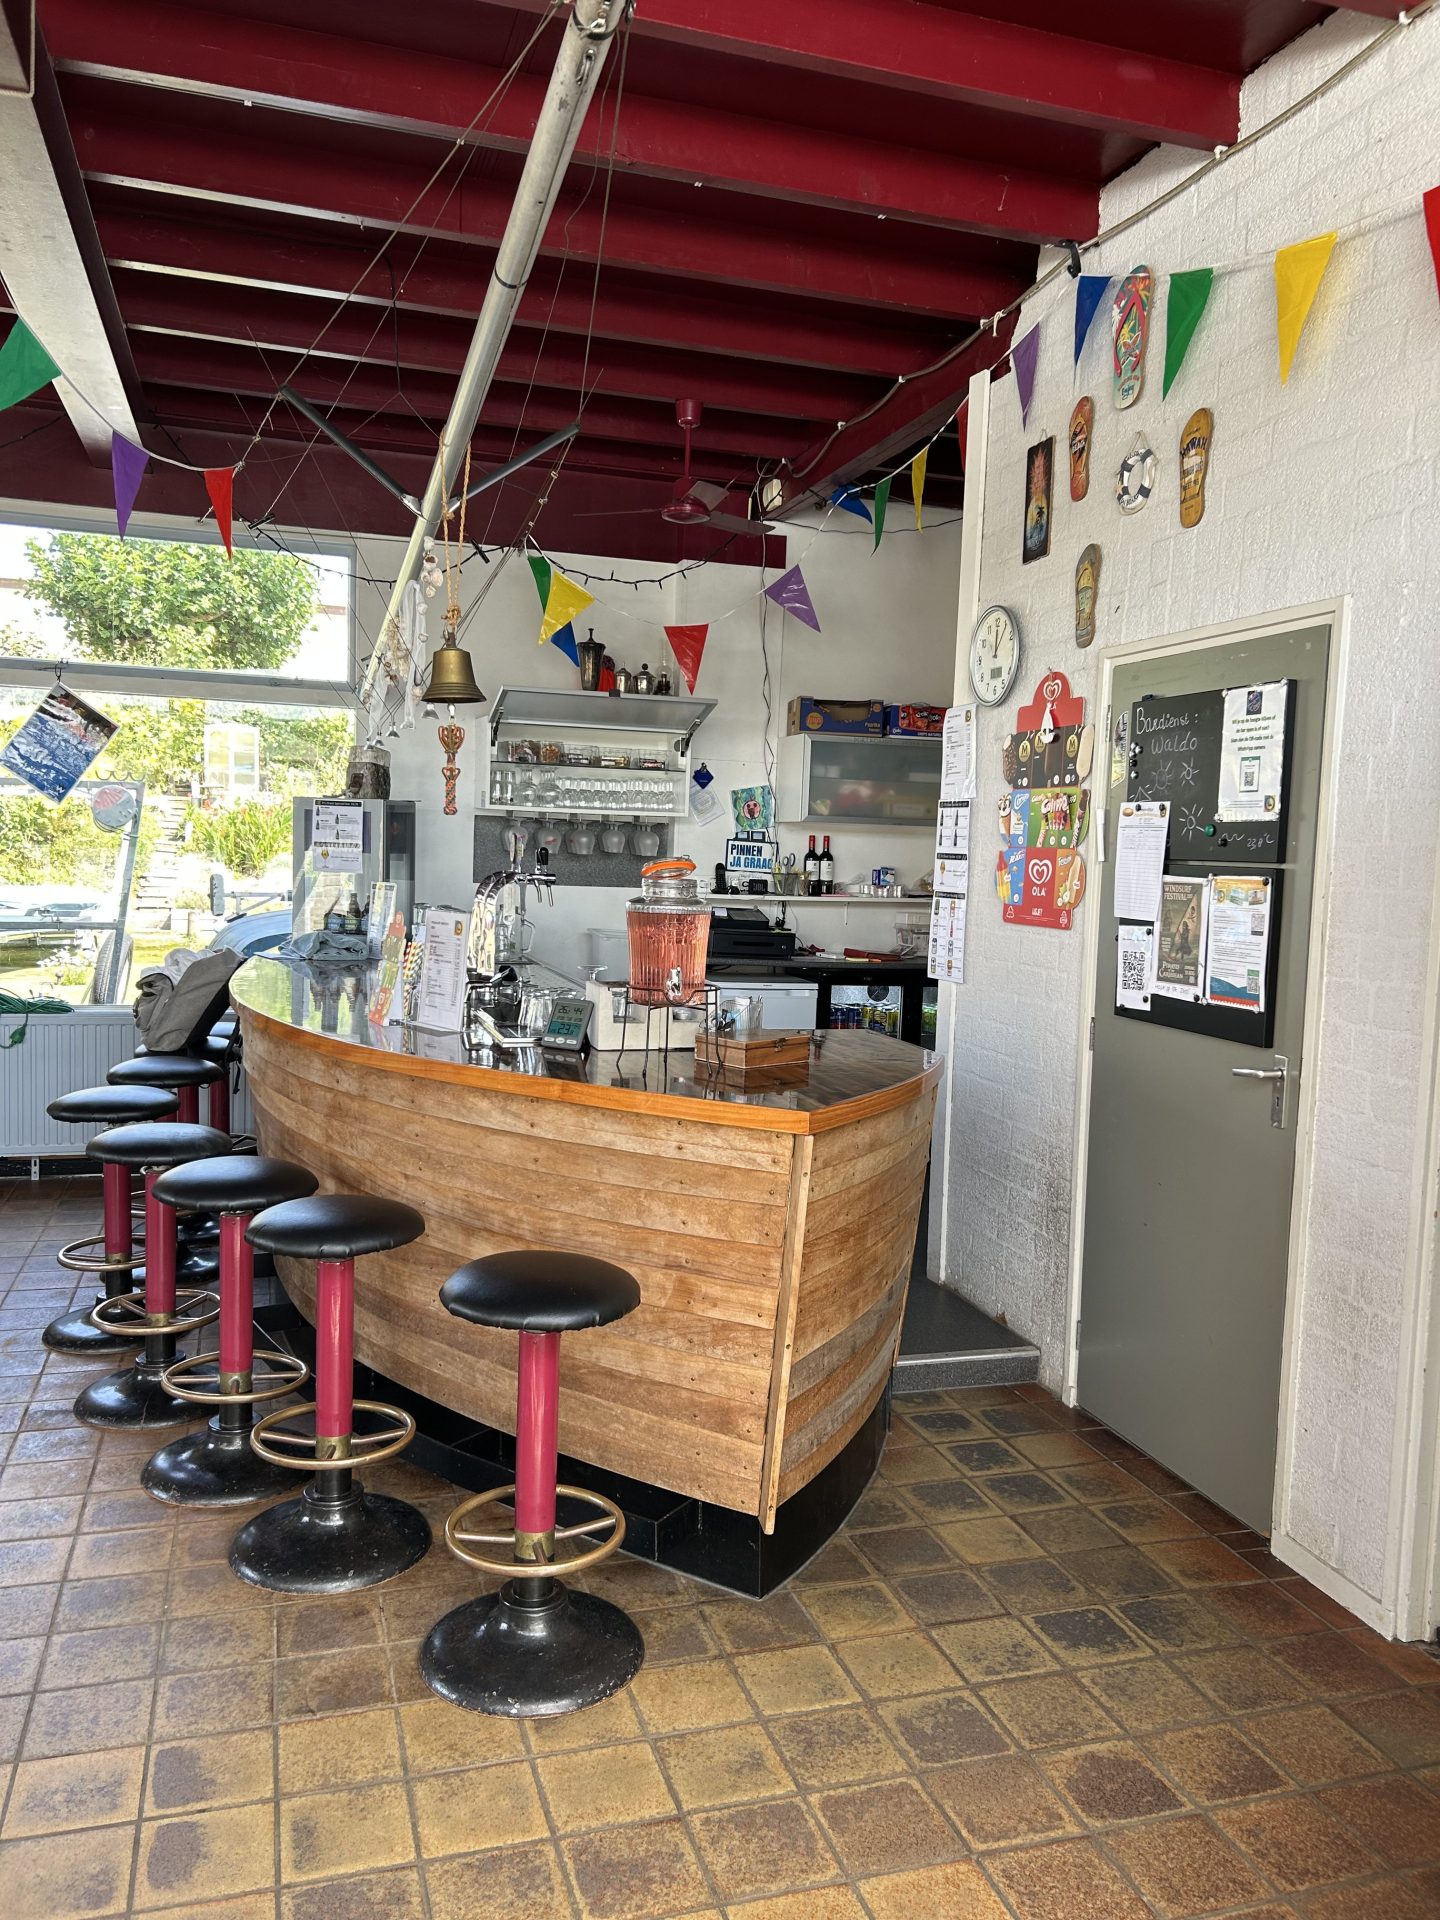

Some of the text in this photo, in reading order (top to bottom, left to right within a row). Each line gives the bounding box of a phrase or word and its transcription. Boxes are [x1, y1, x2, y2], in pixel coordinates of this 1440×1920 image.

[730, 843, 763, 857] PINNEN
[729, 855, 741, 868] JA
[1032, 886, 1046, 897] OLA
[1163, 884, 1192, 893] WINDSURF
[1163, 892, 1188, 901] FESTIVAL
